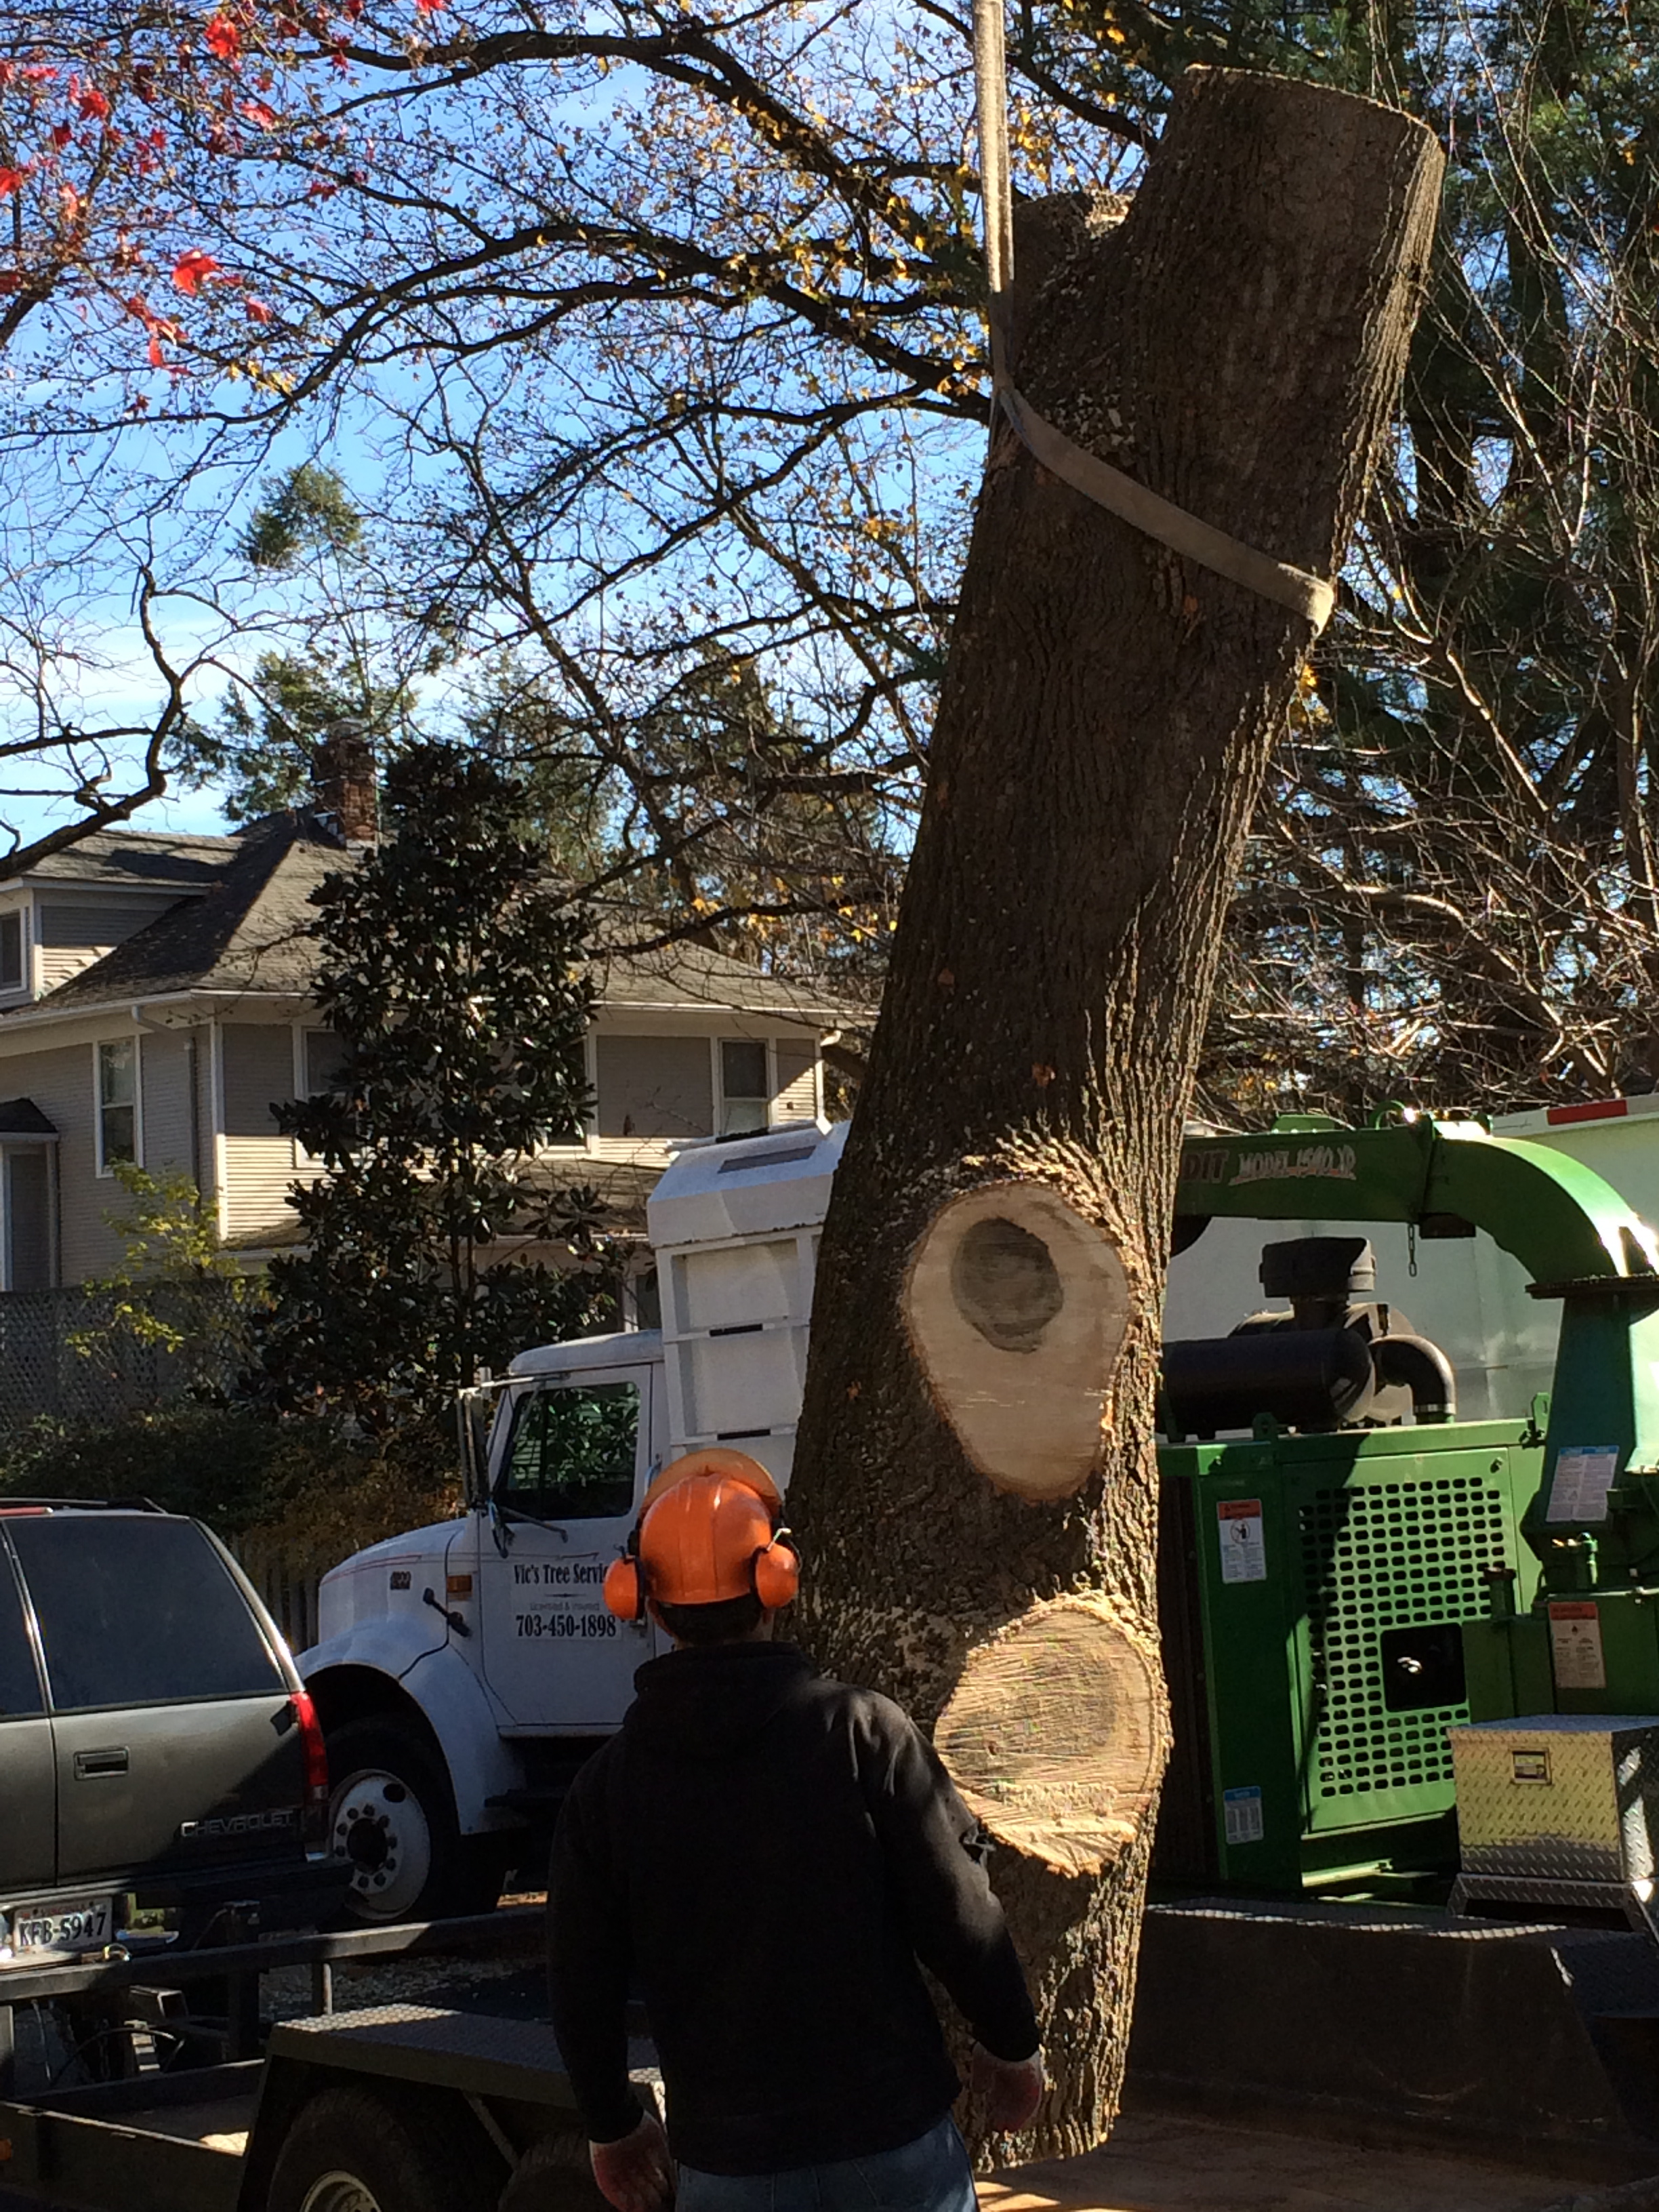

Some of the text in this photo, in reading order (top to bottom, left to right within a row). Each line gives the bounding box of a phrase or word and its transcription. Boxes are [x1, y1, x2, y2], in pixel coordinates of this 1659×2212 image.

[1181, 1150, 1229, 1183] DIT
[514, 1563, 539, 1585] Vic's
[543, 1564, 570, 1584] Tree
[516, 1614, 617, 1638] 703-450-1898
[181, 1809, 293, 1837] CHEVROLET
[19, 1911, 106, 1947] KFB-5947
